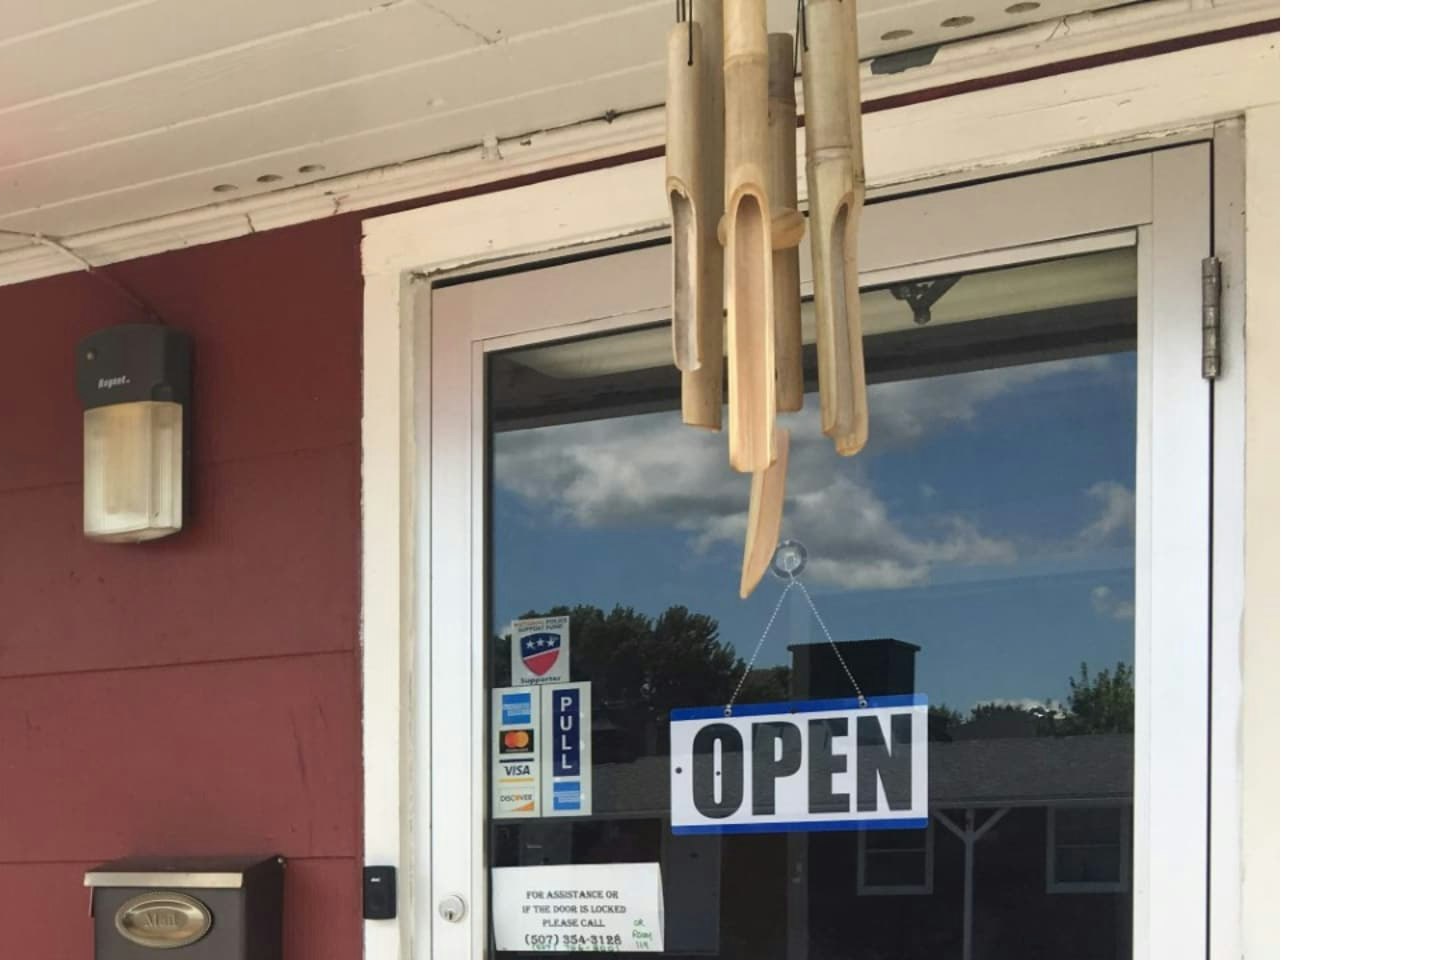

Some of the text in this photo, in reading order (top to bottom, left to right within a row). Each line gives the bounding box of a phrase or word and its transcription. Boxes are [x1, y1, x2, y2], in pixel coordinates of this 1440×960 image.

[560, 696, 573, 769] PULL
[504, 765, 531, 776] VISA
[692, 713, 913, 819] OPEN
[526, 890, 619, 900] FOR ASSISTANCE OR
[522, 905, 626, 914] IF THE DOOR IS LOCKED
[542, 919, 605, 927] PLEASE CALL
[524, 934, 622, 946] (507) 354-3128
